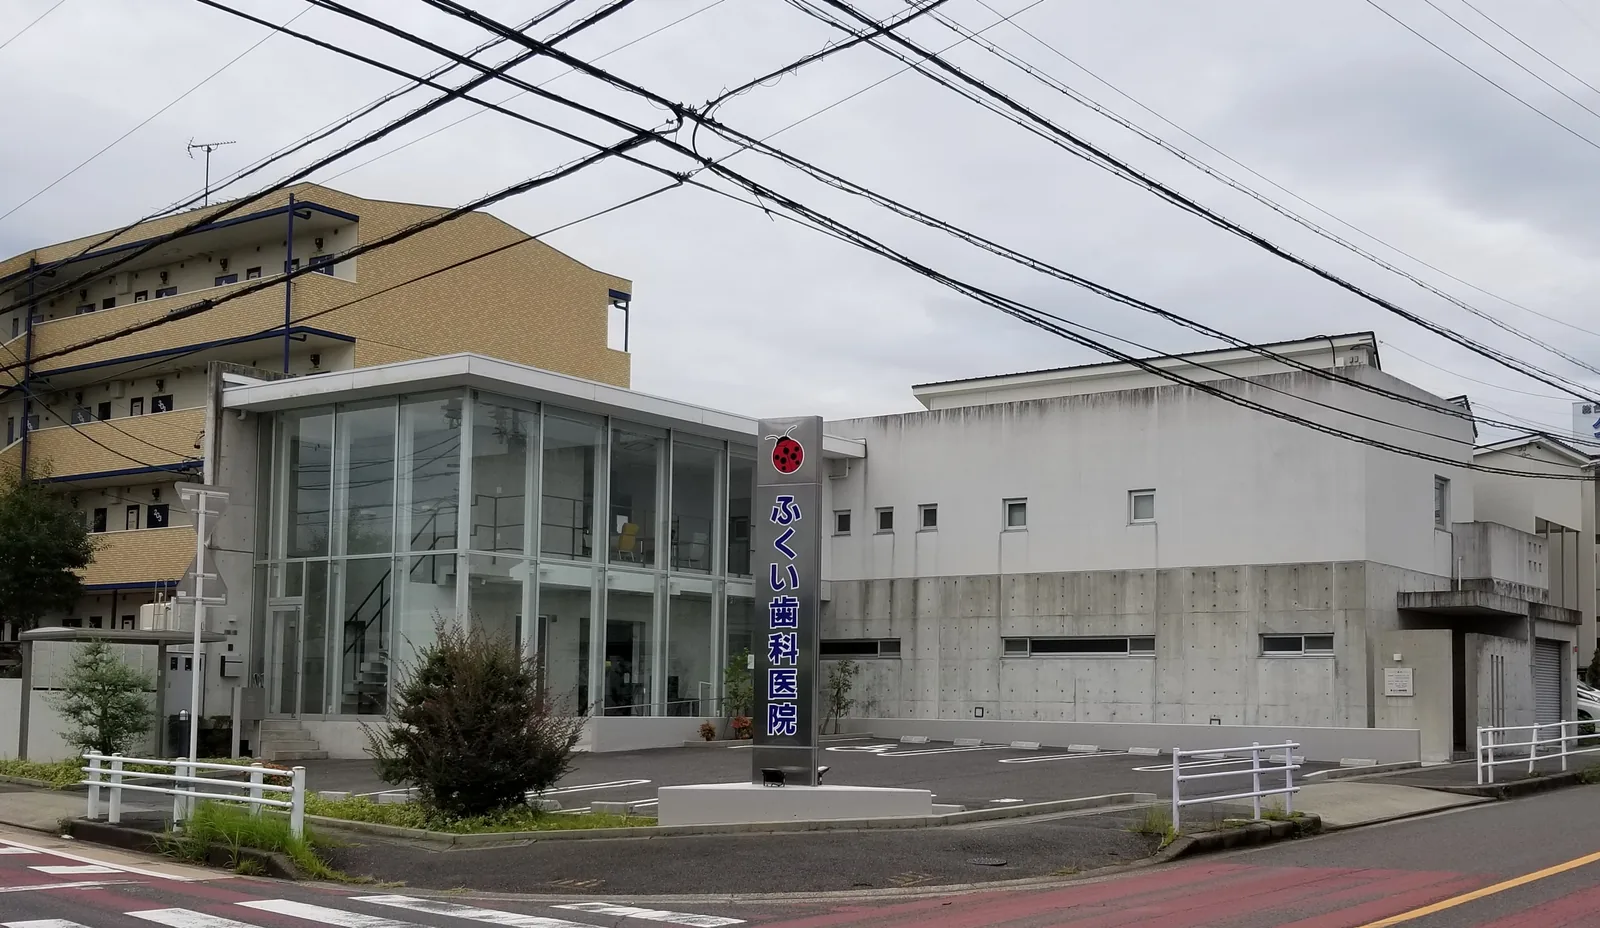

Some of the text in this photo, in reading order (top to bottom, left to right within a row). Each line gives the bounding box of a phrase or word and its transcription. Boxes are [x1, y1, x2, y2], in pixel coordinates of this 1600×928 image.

[767, 495, 801, 736] ふくい歯科医院
